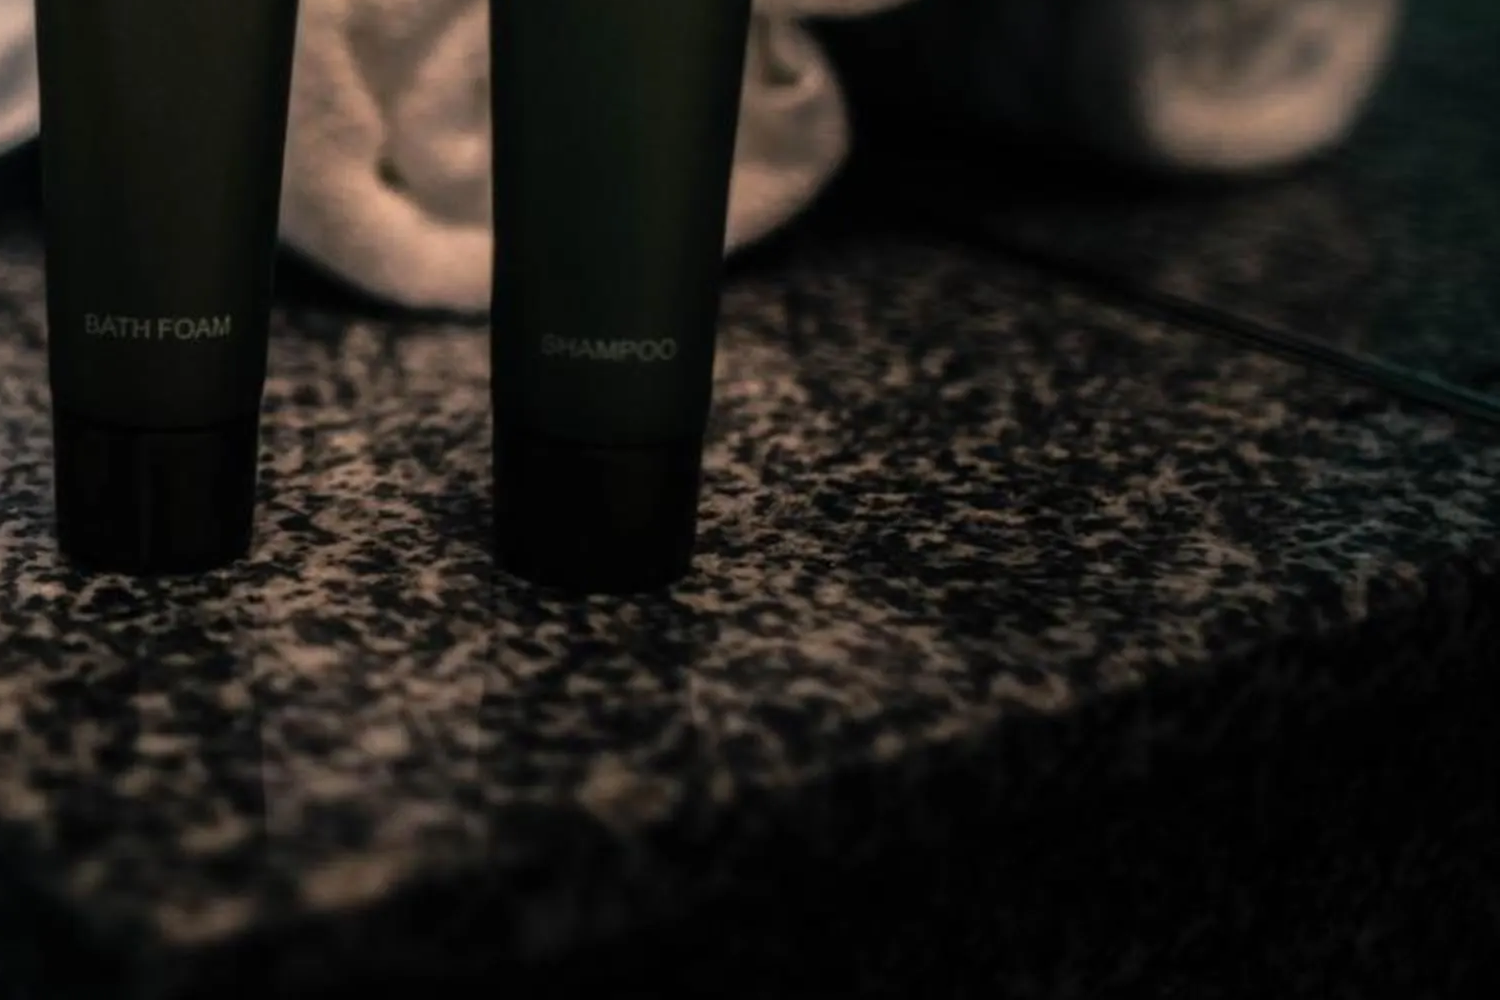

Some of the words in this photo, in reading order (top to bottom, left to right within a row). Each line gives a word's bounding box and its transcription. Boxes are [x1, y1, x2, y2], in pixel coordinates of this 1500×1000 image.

[83, 312, 151, 339] BATH
[158, 313, 232, 341] FOAM
[541, 332, 679, 362] SHAMPOO
